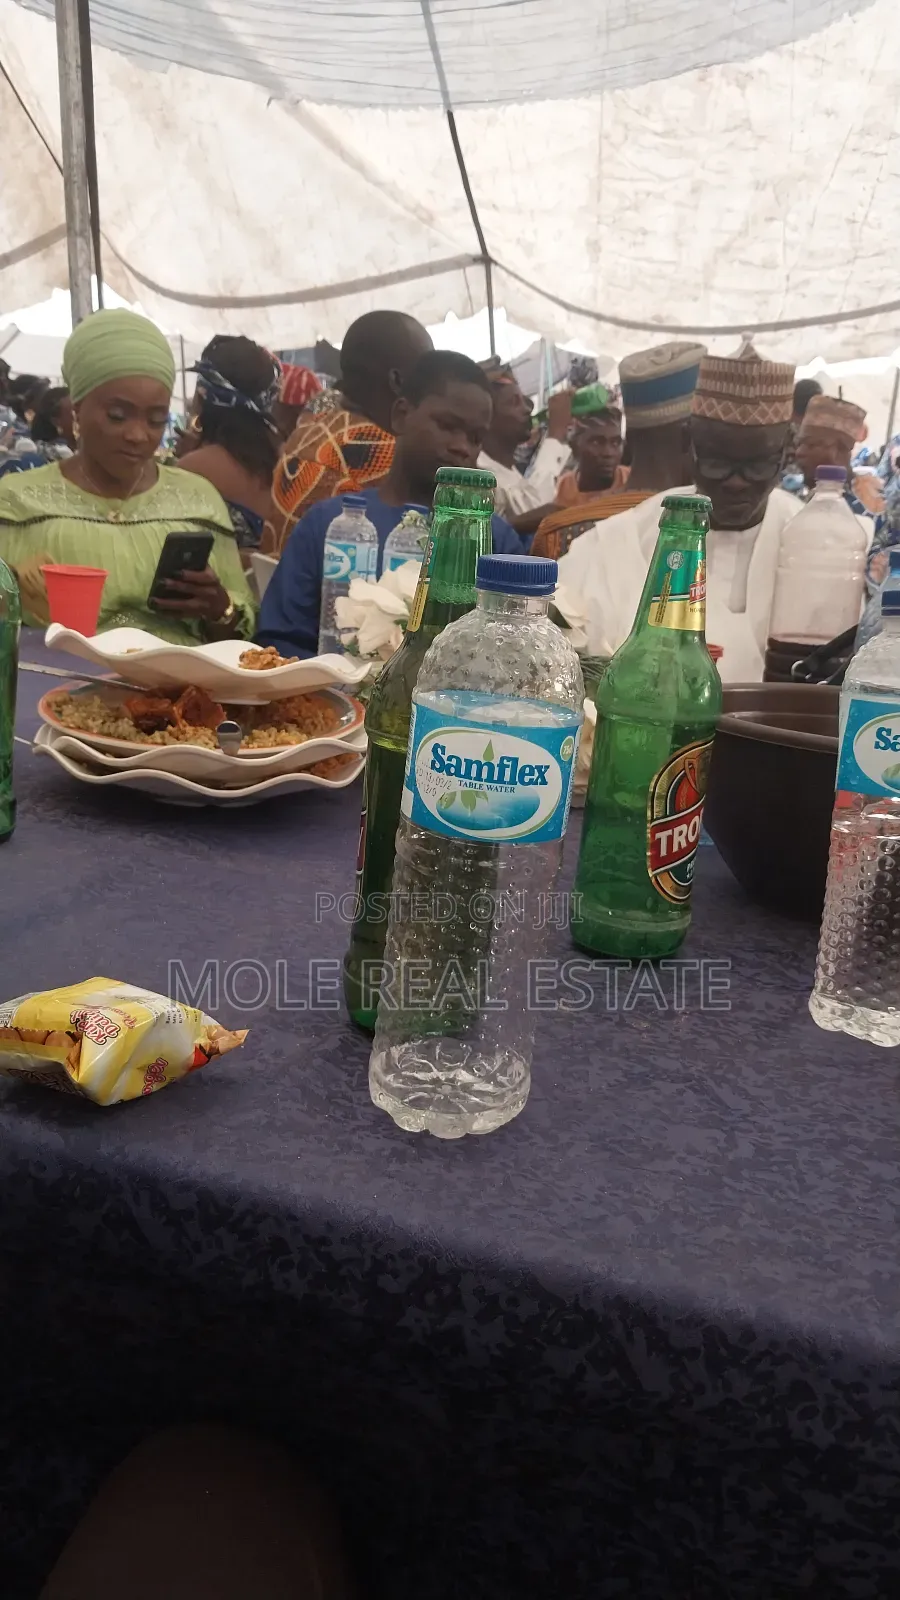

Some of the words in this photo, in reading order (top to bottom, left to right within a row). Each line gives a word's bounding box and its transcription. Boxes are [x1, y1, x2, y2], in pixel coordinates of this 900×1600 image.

[431, 743, 550, 786] Samflex
[458, 780, 484, 791] TABLE
[486, 784, 516, 794] WATER
